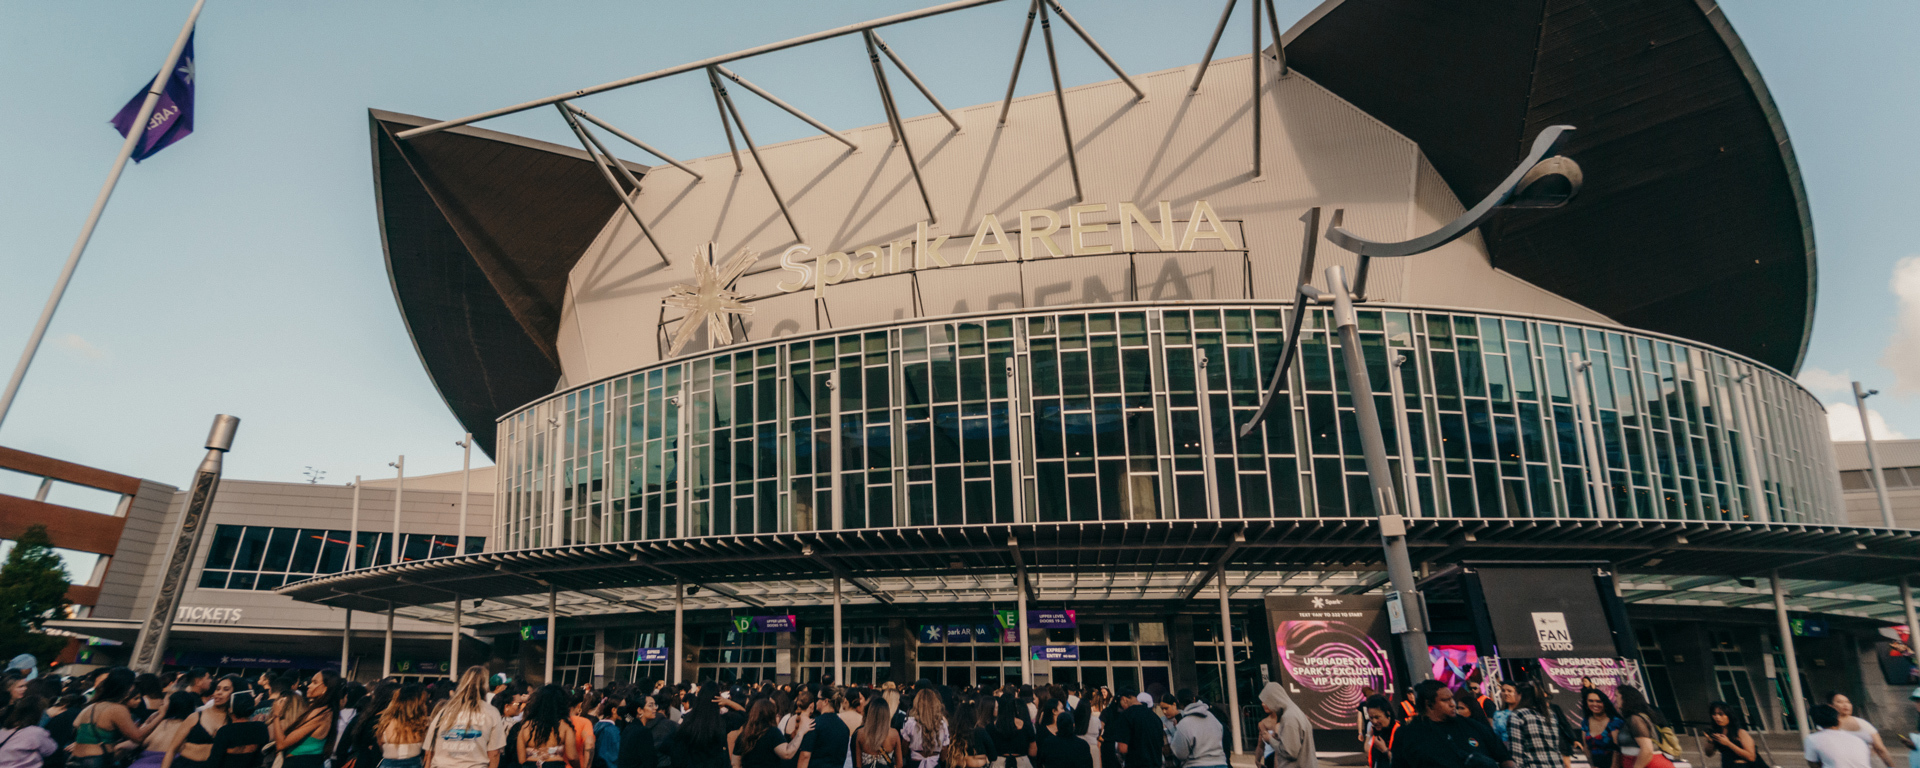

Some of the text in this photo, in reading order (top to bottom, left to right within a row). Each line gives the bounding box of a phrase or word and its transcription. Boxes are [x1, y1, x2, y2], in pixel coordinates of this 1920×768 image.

[776, 200, 1238, 298] Spark ARENA
[179, 606, 243, 621] TICKETS
[741, 619, 749, 630] D
[1007, 615, 1016, 626] E
[948, 628, 960, 636] park
[1540, 630, 1569, 640] FAN
[1541, 642, 1574, 651] STUDIO
[1303, 657, 1369, 666] UPGRADES TO
[1557, 658, 1614, 666] UPGRADES TO
[1293, 667, 1384, 676] SPARK'S EXCLUSIVE
[1550, 668, 1583, 676] SPARK'S
[1312, 677, 1370, 686] VIP LOUNGE
